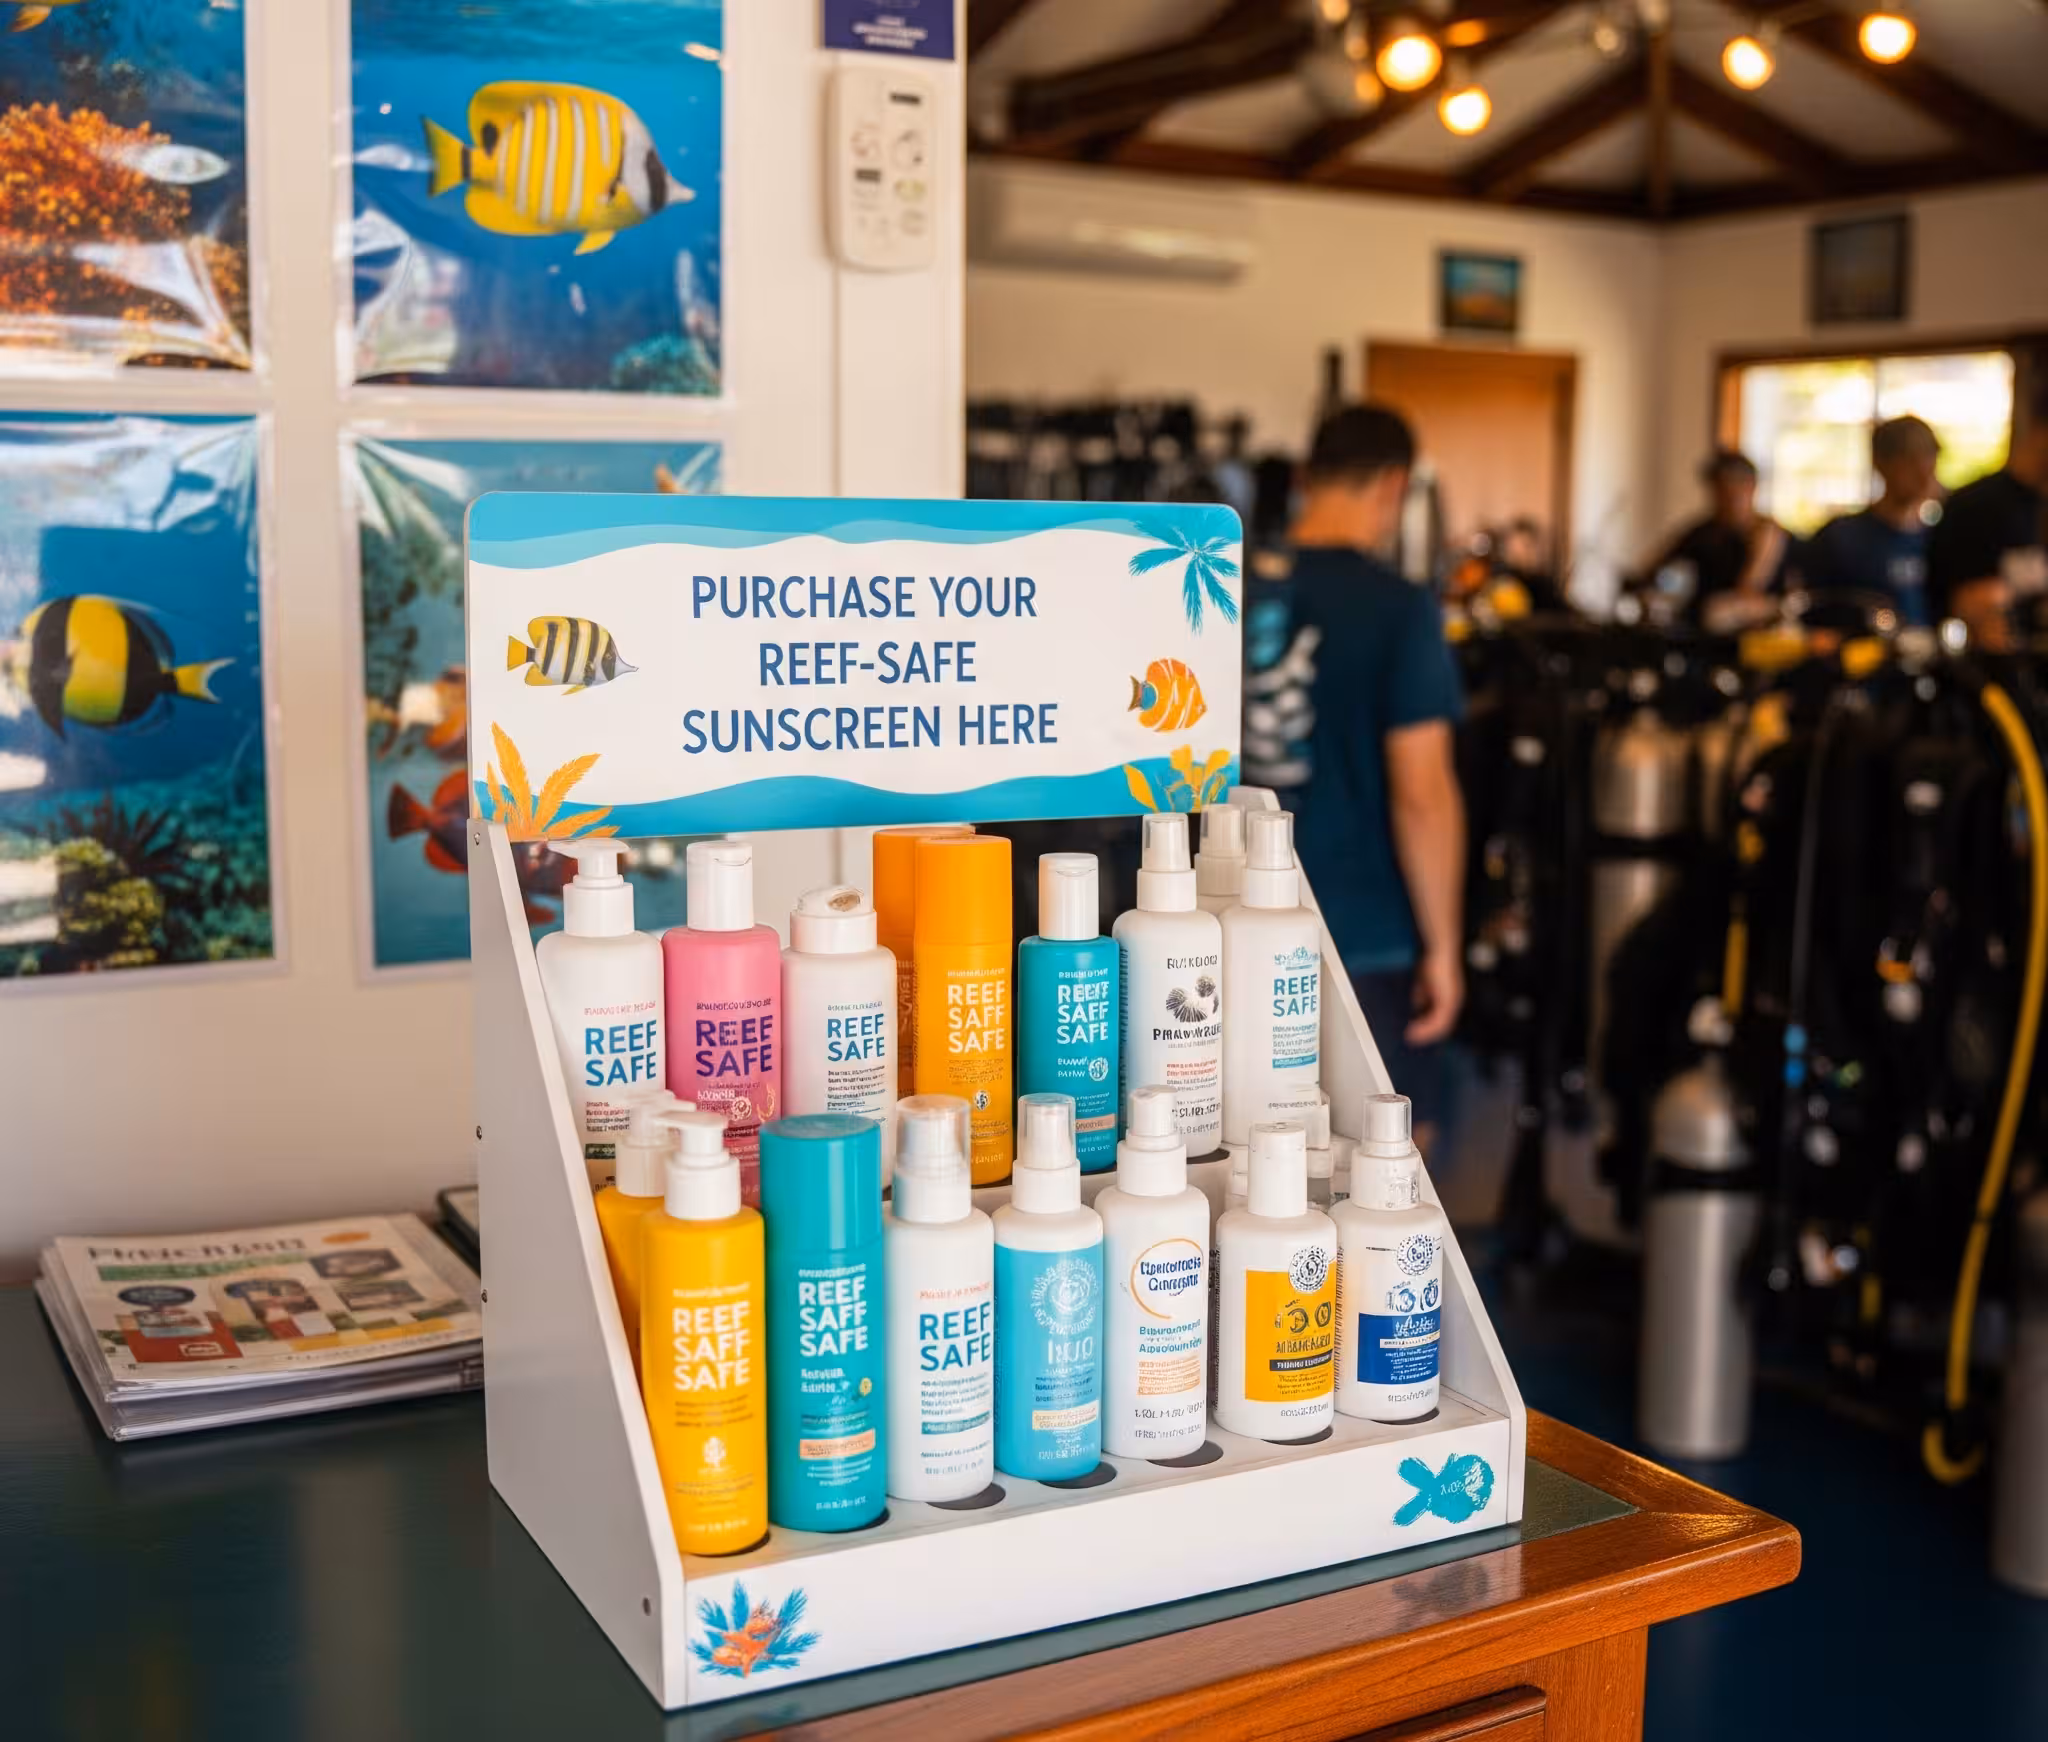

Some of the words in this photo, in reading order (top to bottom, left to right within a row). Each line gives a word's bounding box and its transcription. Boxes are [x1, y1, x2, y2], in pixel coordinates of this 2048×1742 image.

[692, 576, 915, 619] PURCHASE
[929, 577, 1037, 618] YOUR
[760, 641, 976, 686] REEF-SAFE
[683, 707, 941, 754] SUNSCREEN
[959, 704, 1058, 746] HERE
[947, 980, 1006, 1006] REEF
[1273, 973, 1318, 996] REEF
[1272, 994, 1317, 1018] SAFE
[585, 1019, 657, 1055] REEF
[827, 1013, 885, 1039] REEF
[948, 1028, 1006, 1054] SAFE
[1056, 1022, 1109, 1045] SAFE
[695, 1044, 773, 1078] SAFE
[827, 1036, 886, 1062] SAFE
[585, 1051, 657, 1087] SAFE
[799, 1275, 866, 1305] REEF
[672, 1301, 750, 1335] REEF
[919, 1301, 991, 1341] REEF
[800, 1326, 868, 1357] SAFE
[920, 1332, 991, 1372] SAFE
